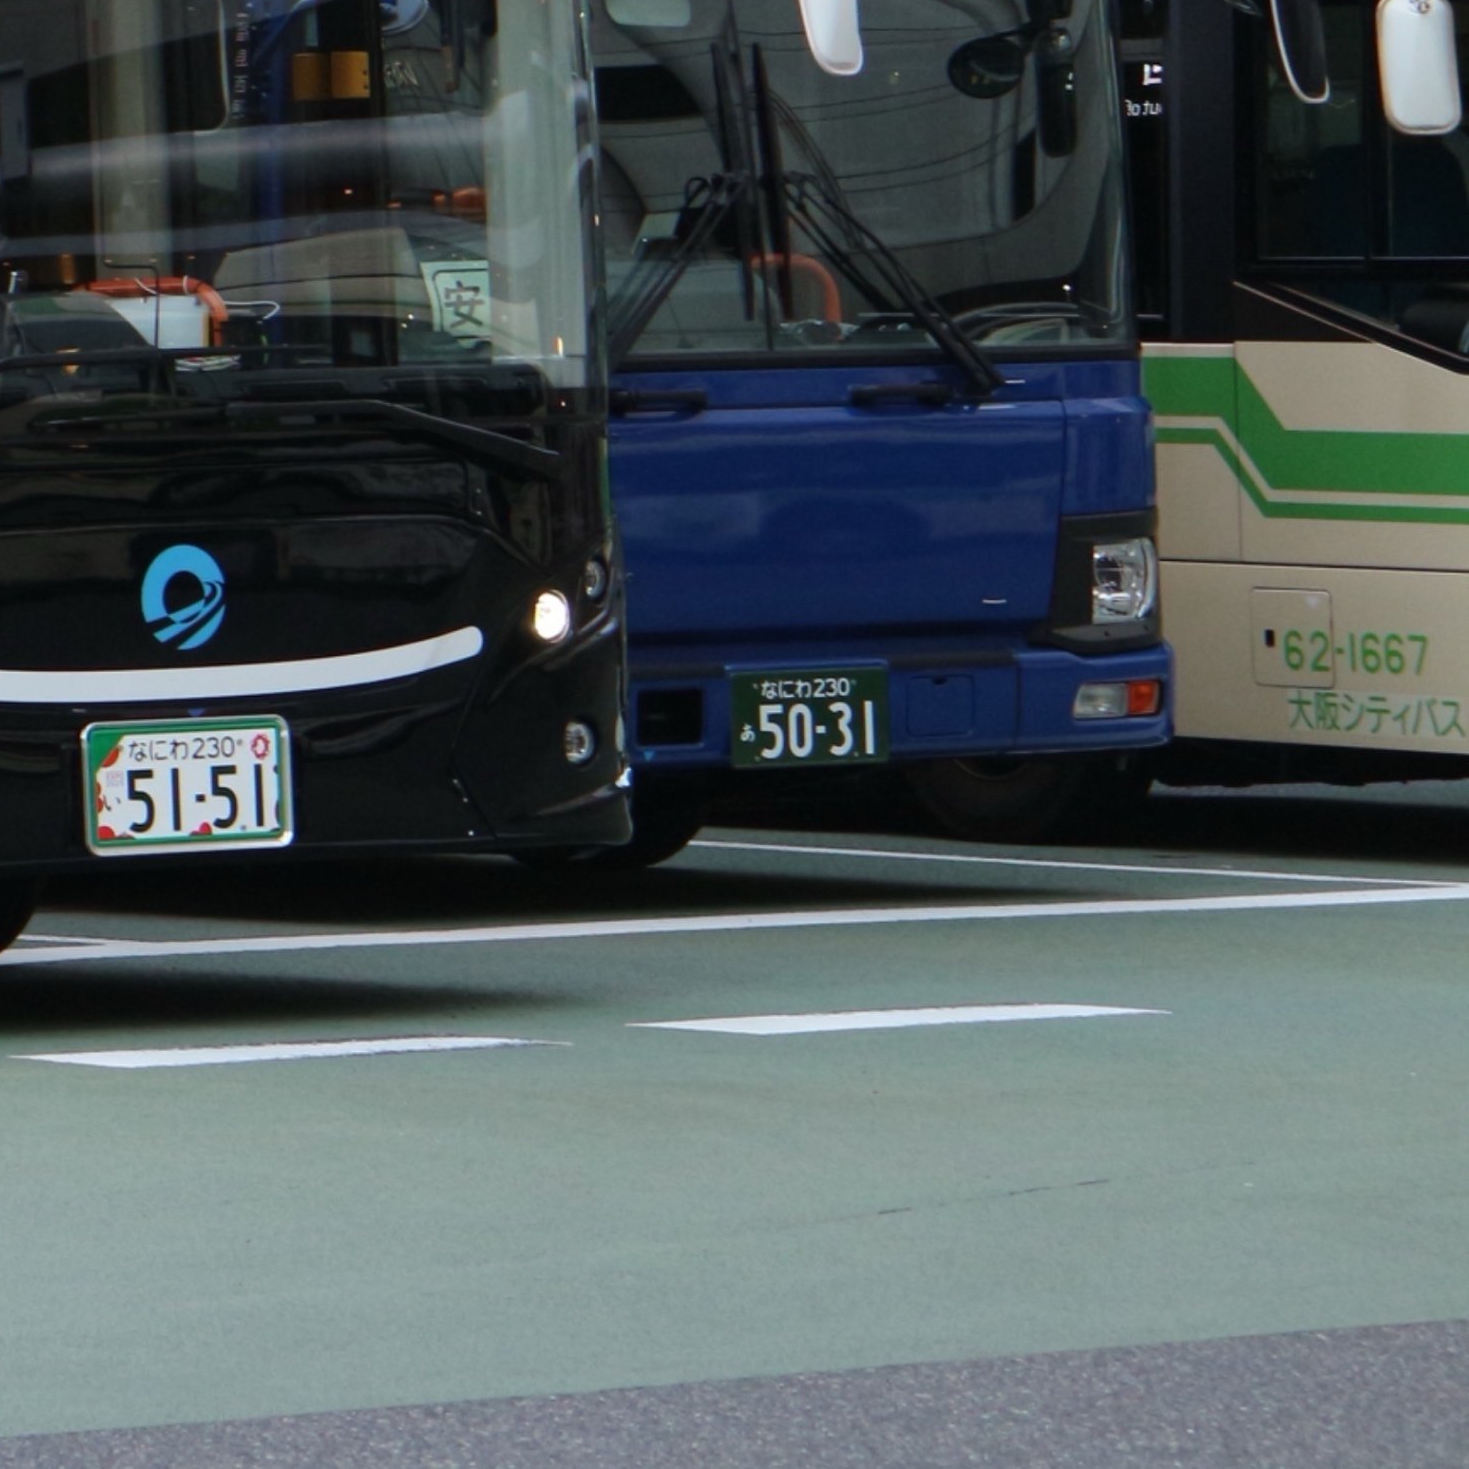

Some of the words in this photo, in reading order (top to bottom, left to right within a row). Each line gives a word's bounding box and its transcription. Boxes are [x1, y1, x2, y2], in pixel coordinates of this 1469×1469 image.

[444, 280, 485, 328] 安
[1283, 630, 1428, 675] 62-1667
[759, 700, 875, 759] 50-31
[1288, 691, 1466, 738] 大阪シティバス
[127, 763, 265, 833] 51-51
